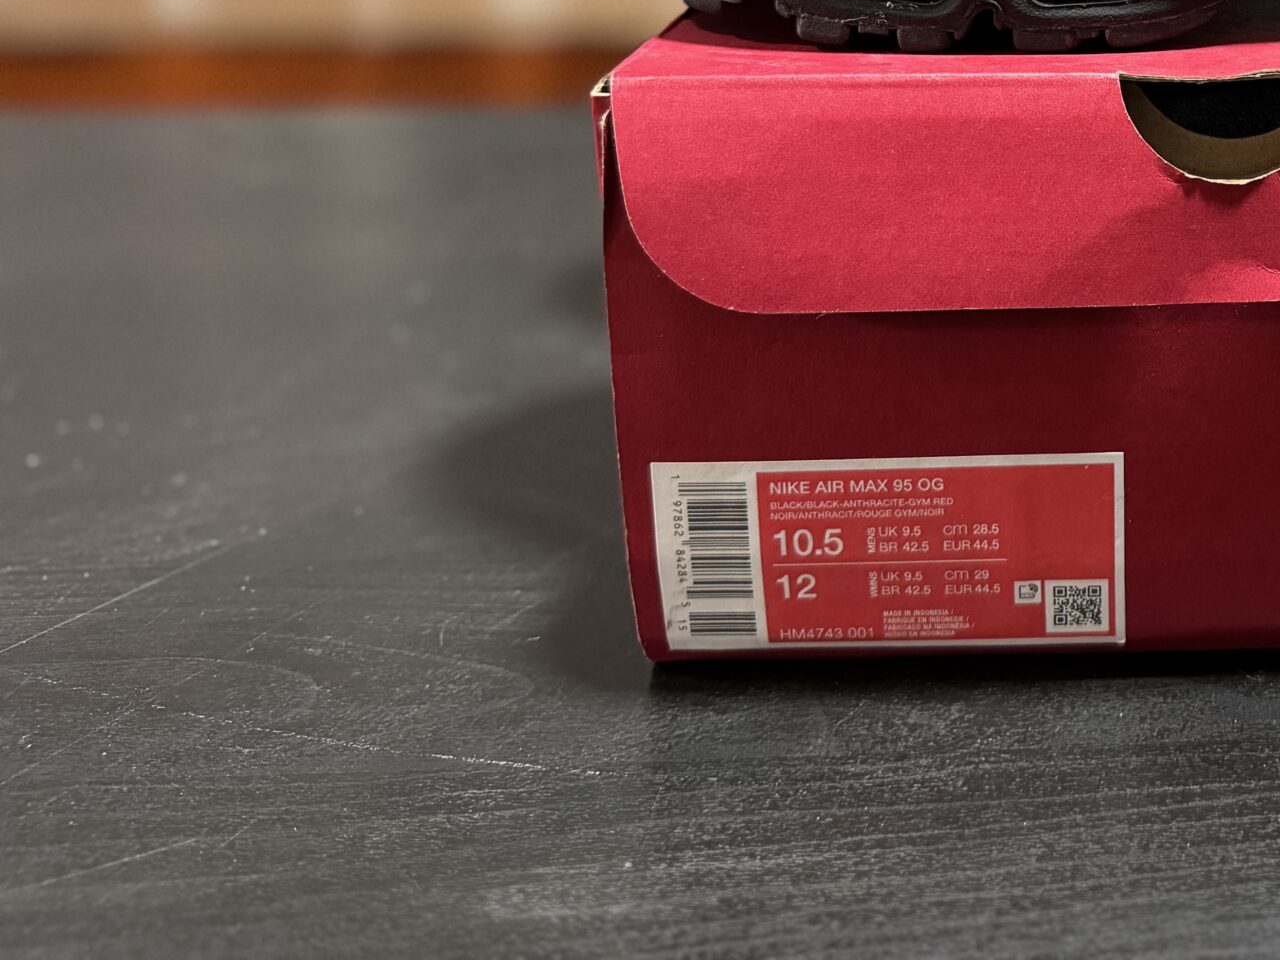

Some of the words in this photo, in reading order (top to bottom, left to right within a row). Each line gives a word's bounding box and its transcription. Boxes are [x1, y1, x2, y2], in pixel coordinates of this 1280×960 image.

[770, 481, 810, 494] NIKE
[815, 480, 844, 493] AIR
[850, 479, 888, 492] MAX
[893, 478, 912, 491] 95
[918, 478, 944, 491] OG
[770, 498, 931, 509] BLACK/BLACK-ANTHRACITE-GYM
[934, 498, 954, 506] RED
[673, 501, 684, 537] 97862
[895, 508, 945, 517] GYM/NOIR
[879, 527, 897, 537] UK
[902, 526, 921, 536] 9.5
[943, 525, 968, 535] cm
[973, 523, 999, 535] 28.5
[773, 528, 844, 556] 10.5
[867, 527, 877, 553] MENS
[879, 542, 897, 552] BR
[903, 541, 929, 552] 42.5
[943, 540, 971, 551] EUR
[973, 539, 1000, 550] 44.5
[676, 549, 687, 583] 84284
[881, 571, 900, 582] UK
[904, 571, 923, 581] 9.5
[944, 569, 969, 580] cm
[974, 569, 989, 579] 29
[776, 574, 817, 599] 12
[869, 571, 878, 598] WMNS
[882, 585, 900, 595] BR
[905, 585, 931, 595] 42.5
[944, 584, 973, 594] EUR
[974, 583, 1001, 594] 44.5
[780, 627, 843, 640] HM4743
[849, 627, 874, 638] 001
